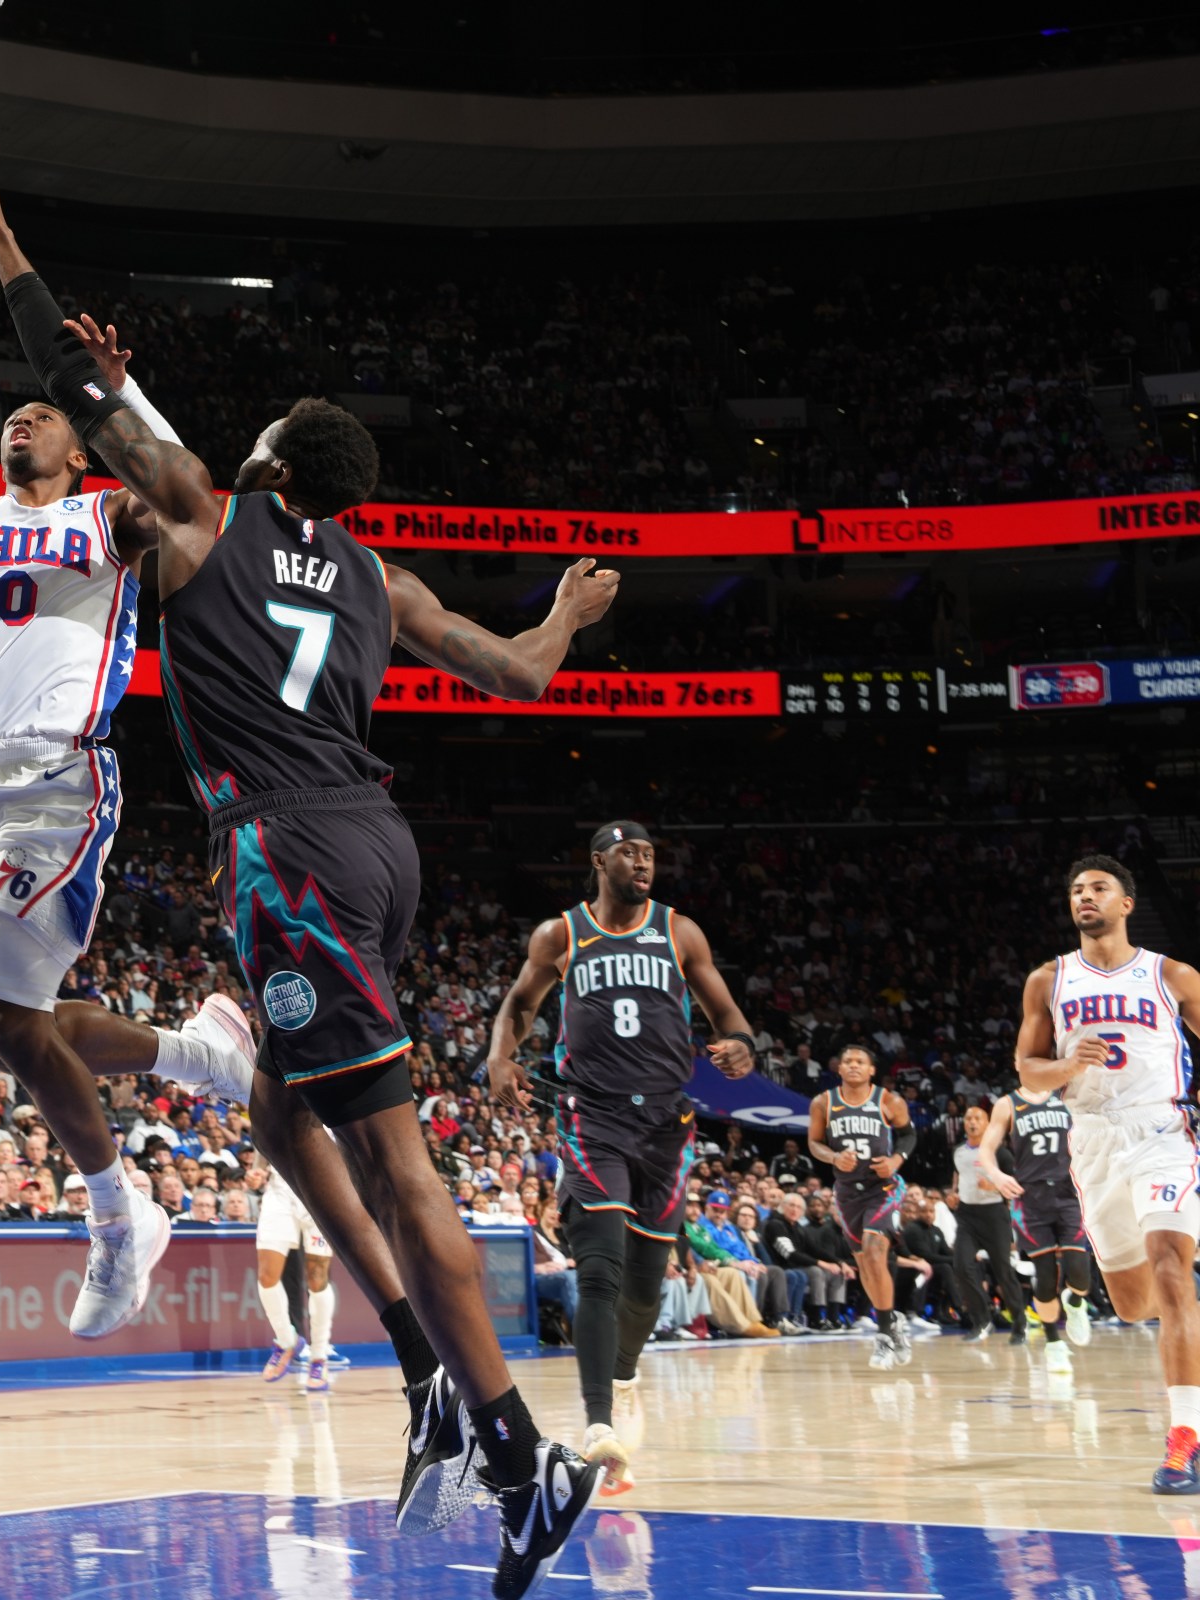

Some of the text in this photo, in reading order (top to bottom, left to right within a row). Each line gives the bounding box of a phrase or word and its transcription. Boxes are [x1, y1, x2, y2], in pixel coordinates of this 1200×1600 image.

[342, 510, 640, 547] the Philadelphia 76ers
[829, 519, 954, 544] INTEGR8
[1100, 500, 1200, 531] INTEGR
[272, 549, 339, 593] REED
[266, 599, 336, 713] 7
[415, 676, 441, 702] of
[504, 680, 666, 713] ladelphia
[676, 682, 754, 707] 76ers
[267, 979, 303, 1001] DETROIT
[574, 953, 673, 998] DETROIT
[271, 992, 309, 1015] PISTONS
[613, 998, 641, 1037] 8
[1060, 994, 1158, 1032] PHILA
[1097, 1033, 1128, 1070] 5
[830, 1115, 882, 1138] DETROIT
[1016, 1110, 1070, 1137] DETROIT
[842, 1138, 871, 1160] 25
[1031, 1131, 1060, 1156] 27
[1151, 1183, 1177, 1202] 76
[54, 1267, 267, 1329] Ck-fil-A
